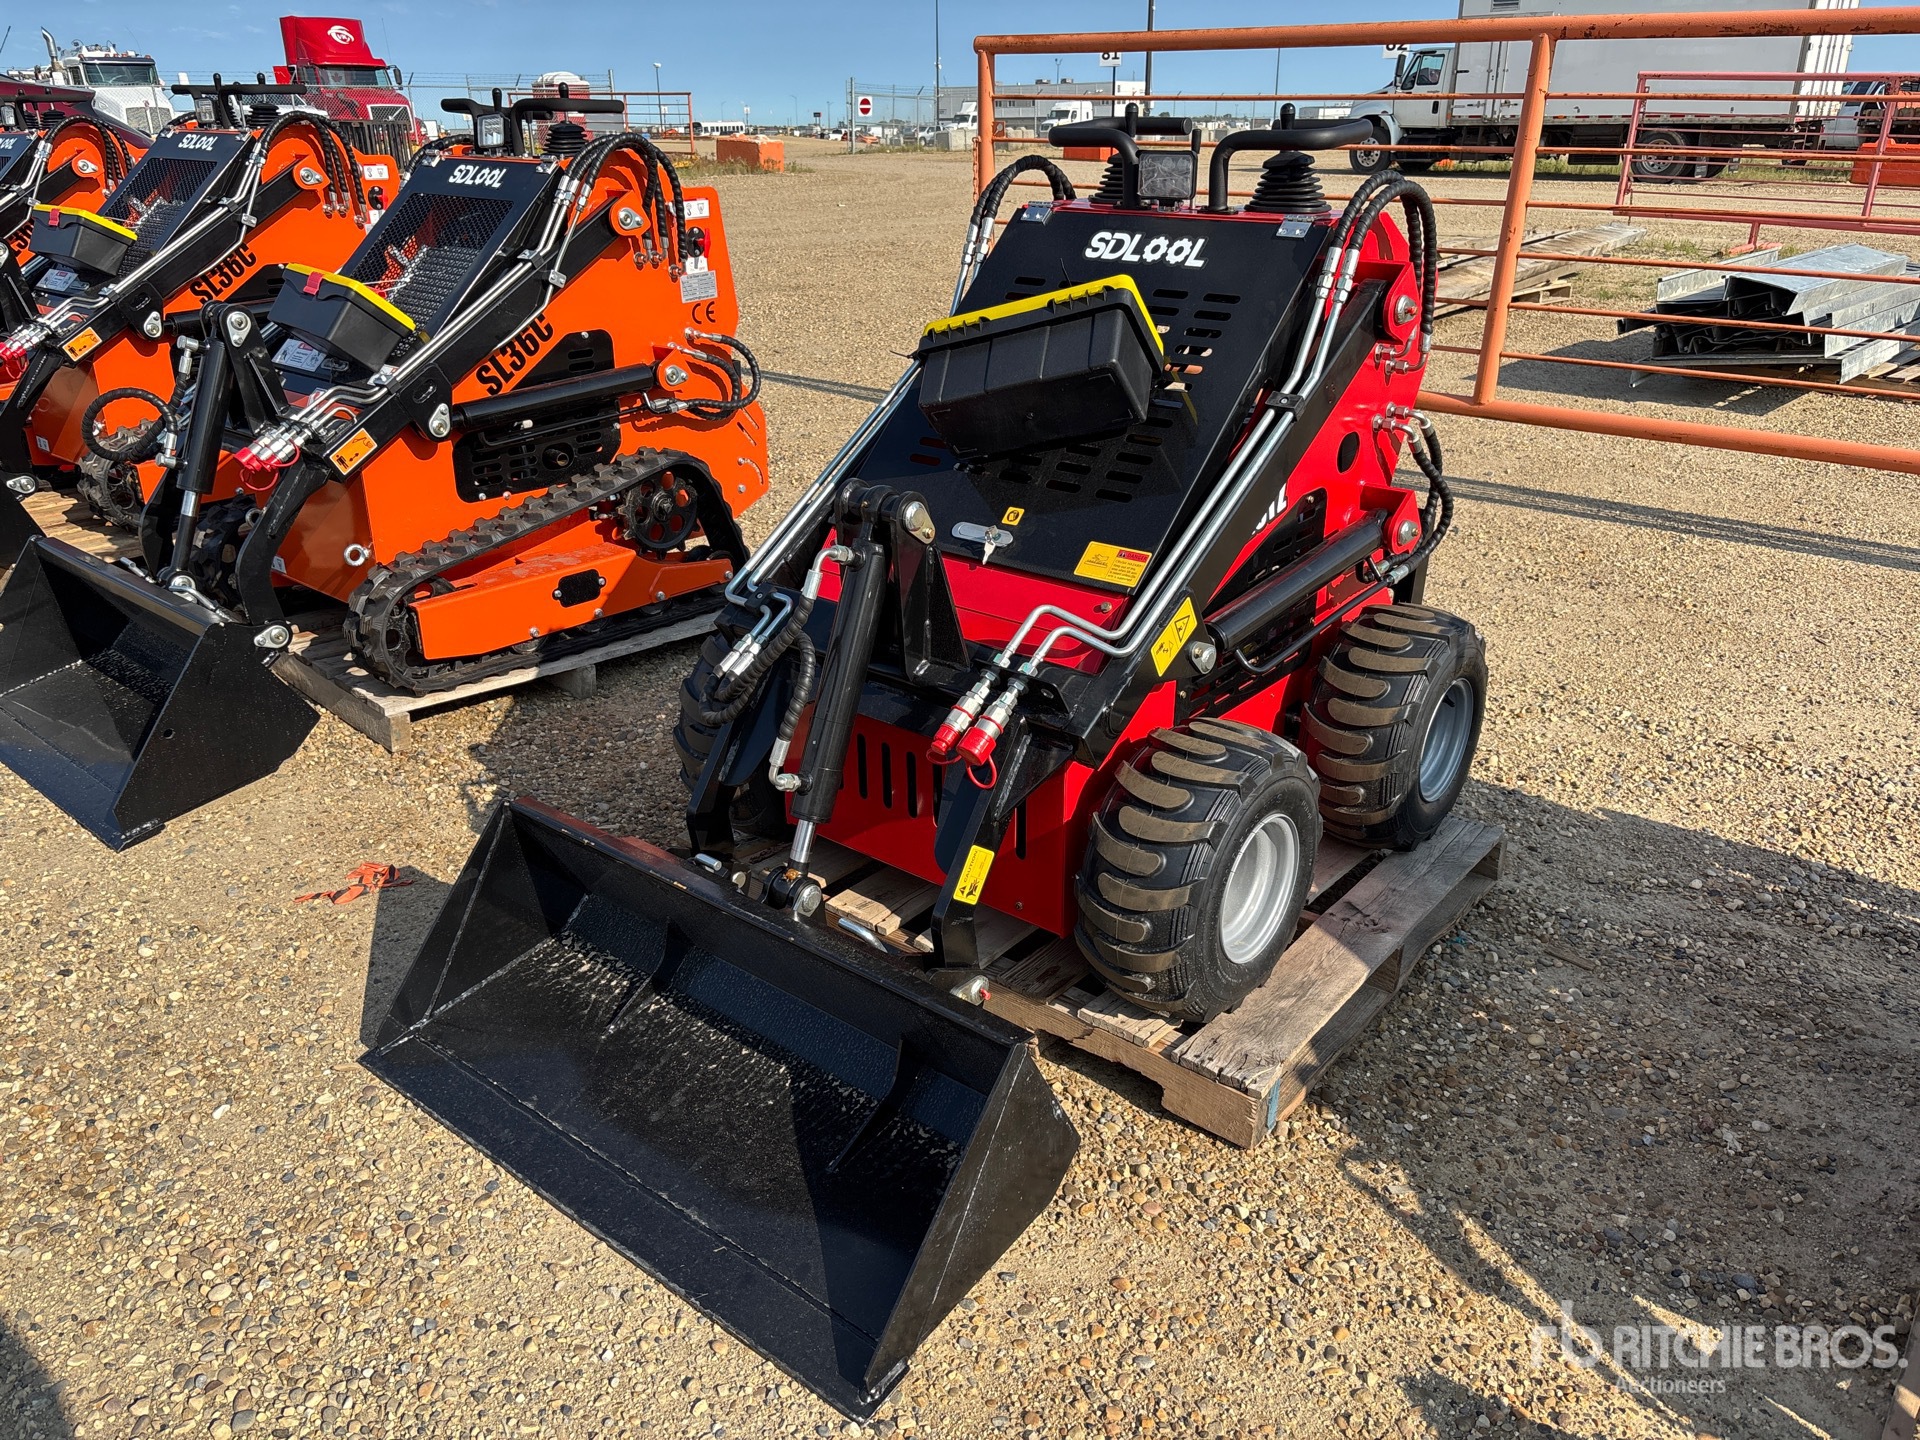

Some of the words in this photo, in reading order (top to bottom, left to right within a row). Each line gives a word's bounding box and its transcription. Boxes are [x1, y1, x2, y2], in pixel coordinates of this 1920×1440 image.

[178, 133, 218, 151] SDLOOL
[448, 164, 507, 188] SDLOOL
[1084, 231, 1206, 268] SDLOOL
[189, 242, 257, 305] SL36C
[475, 313, 554, 396] SL36C
[964, 851, 978, 882] CAUTION
